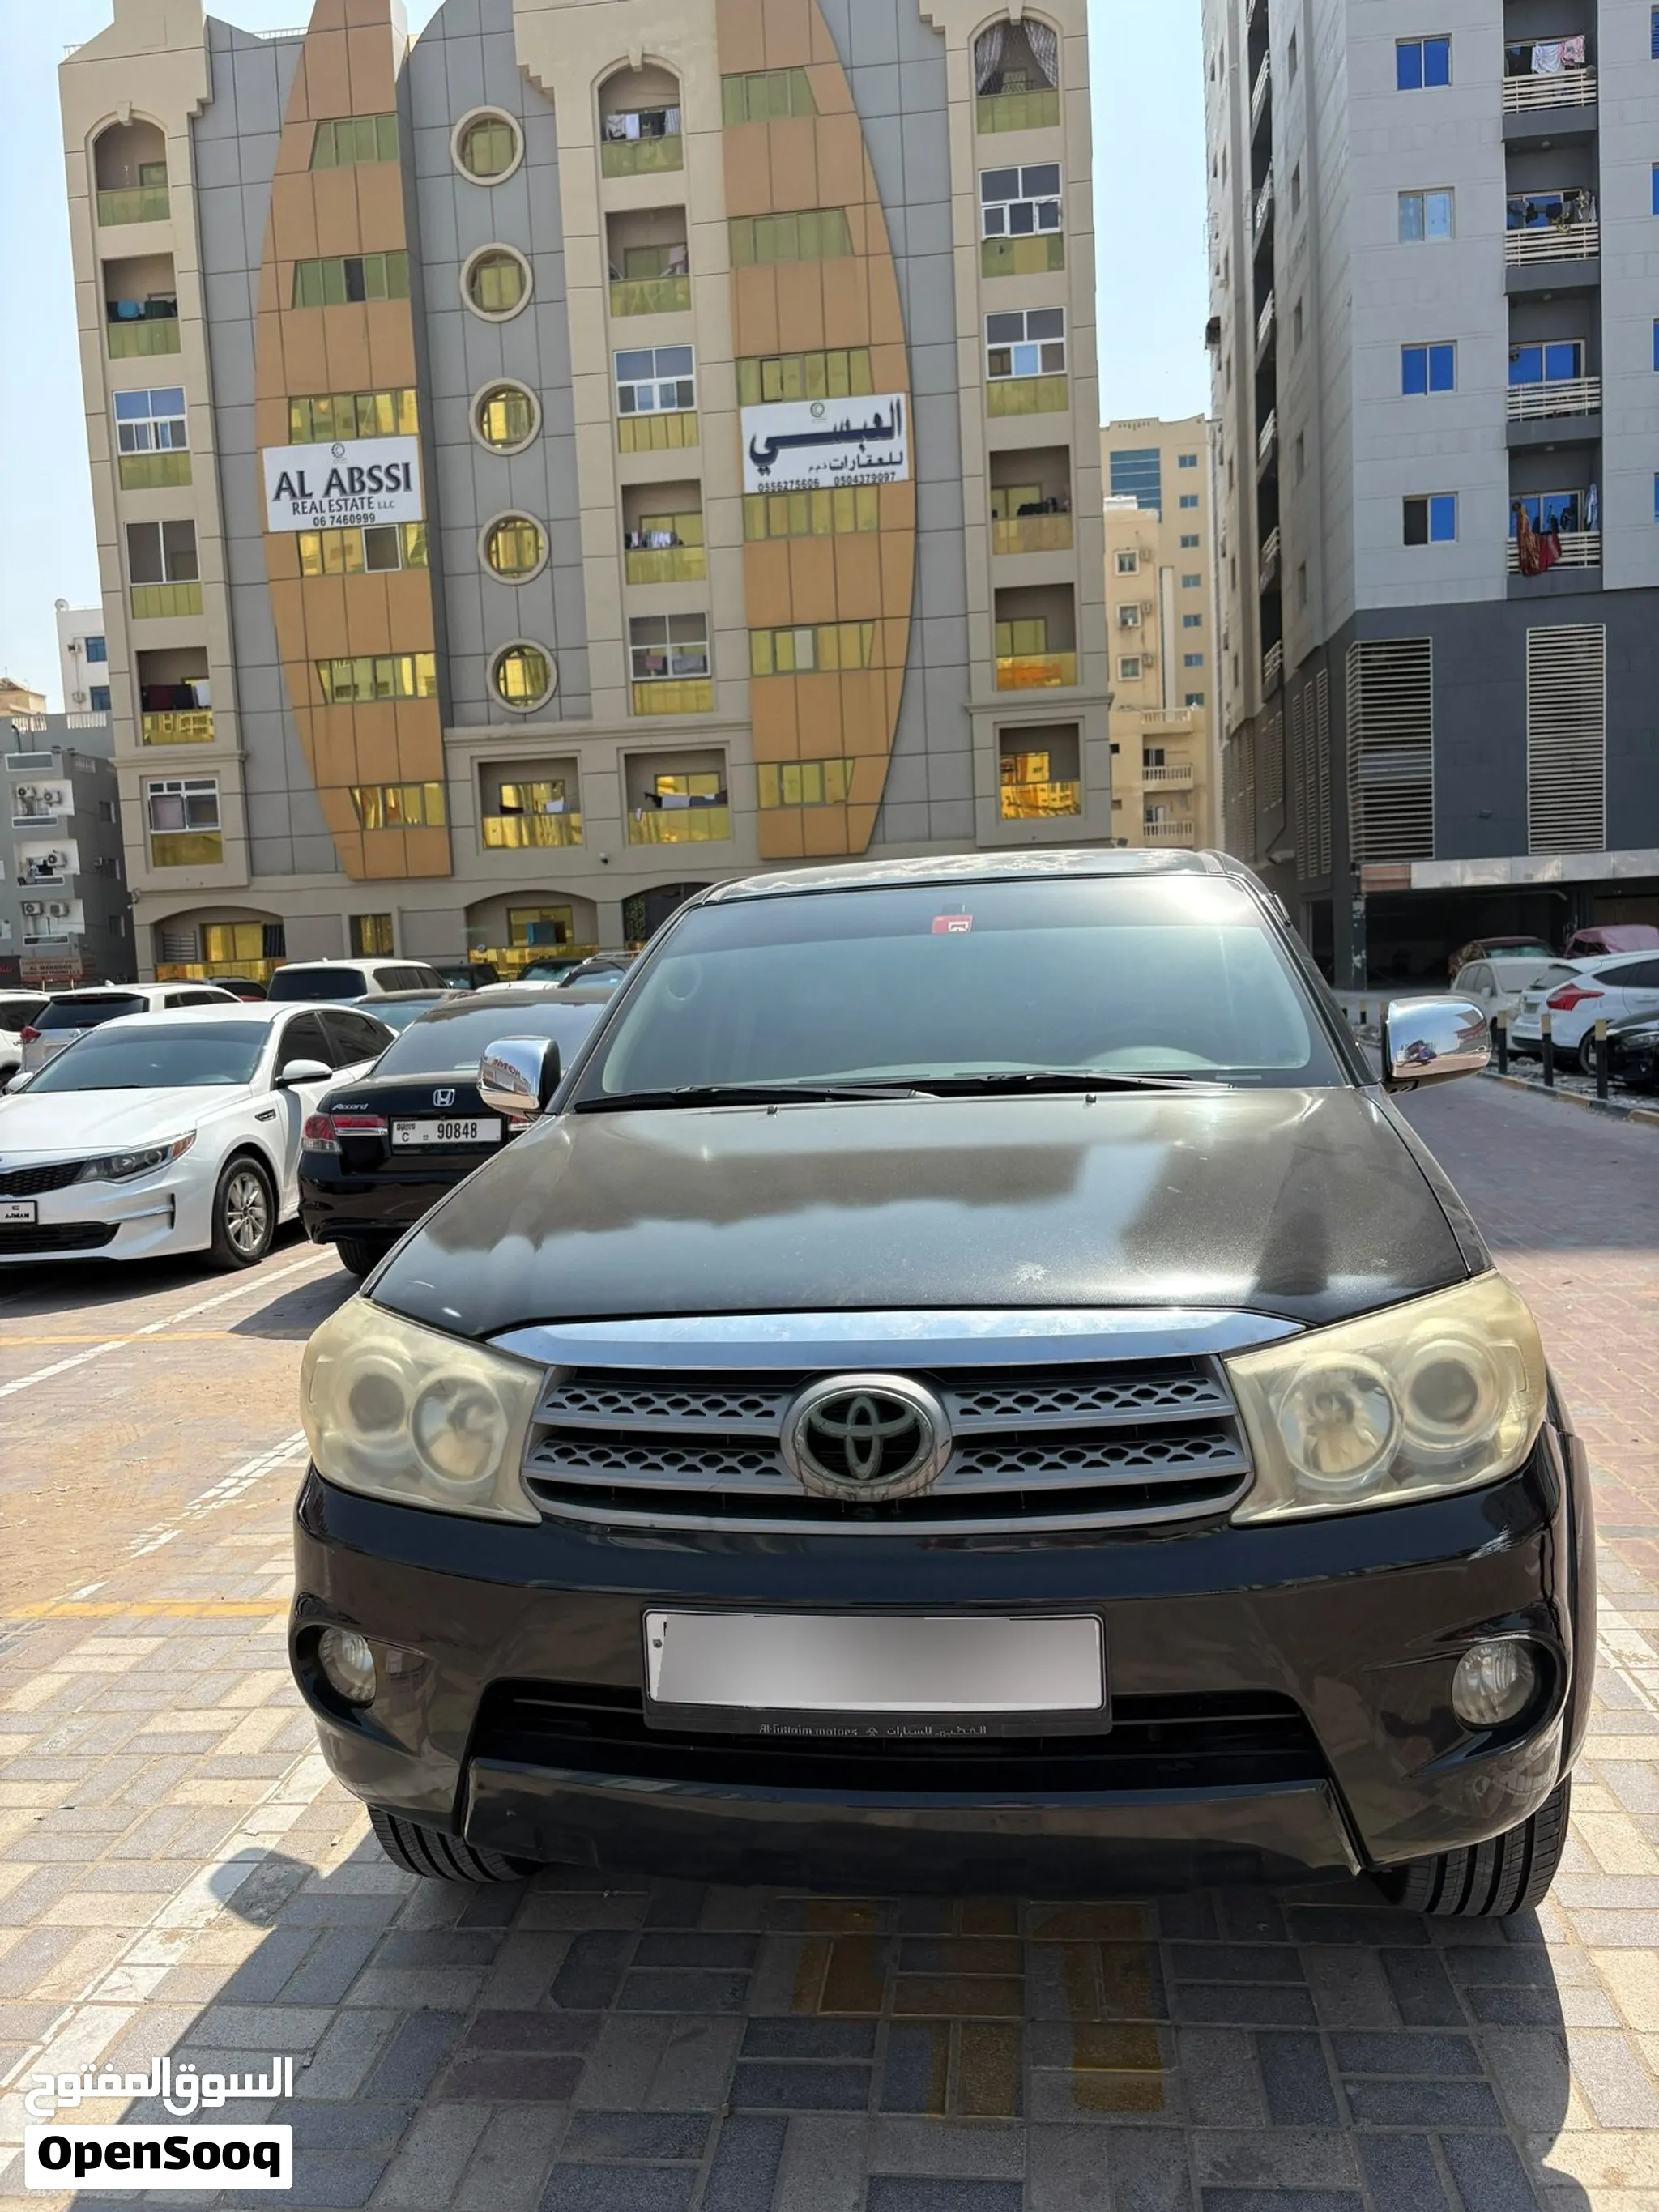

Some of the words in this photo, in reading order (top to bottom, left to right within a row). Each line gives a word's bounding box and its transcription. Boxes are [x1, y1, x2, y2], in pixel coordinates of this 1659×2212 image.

[749, 396, 902, 476] العبسي
[829, 450, 903, 471] للعقارات
[272, 470, 313, 502] AL
[322, 462, 412, 498] ABSSI
[292, 500, 326, 515] REAL
[328, 497, 374, 513] ESTATE
[313, 516, 326, 526] 06
[330, 513, 376, 526] 7460999
[402, 1132, 409, 1142] C
[437, 1122, 478, 1140] 90848
